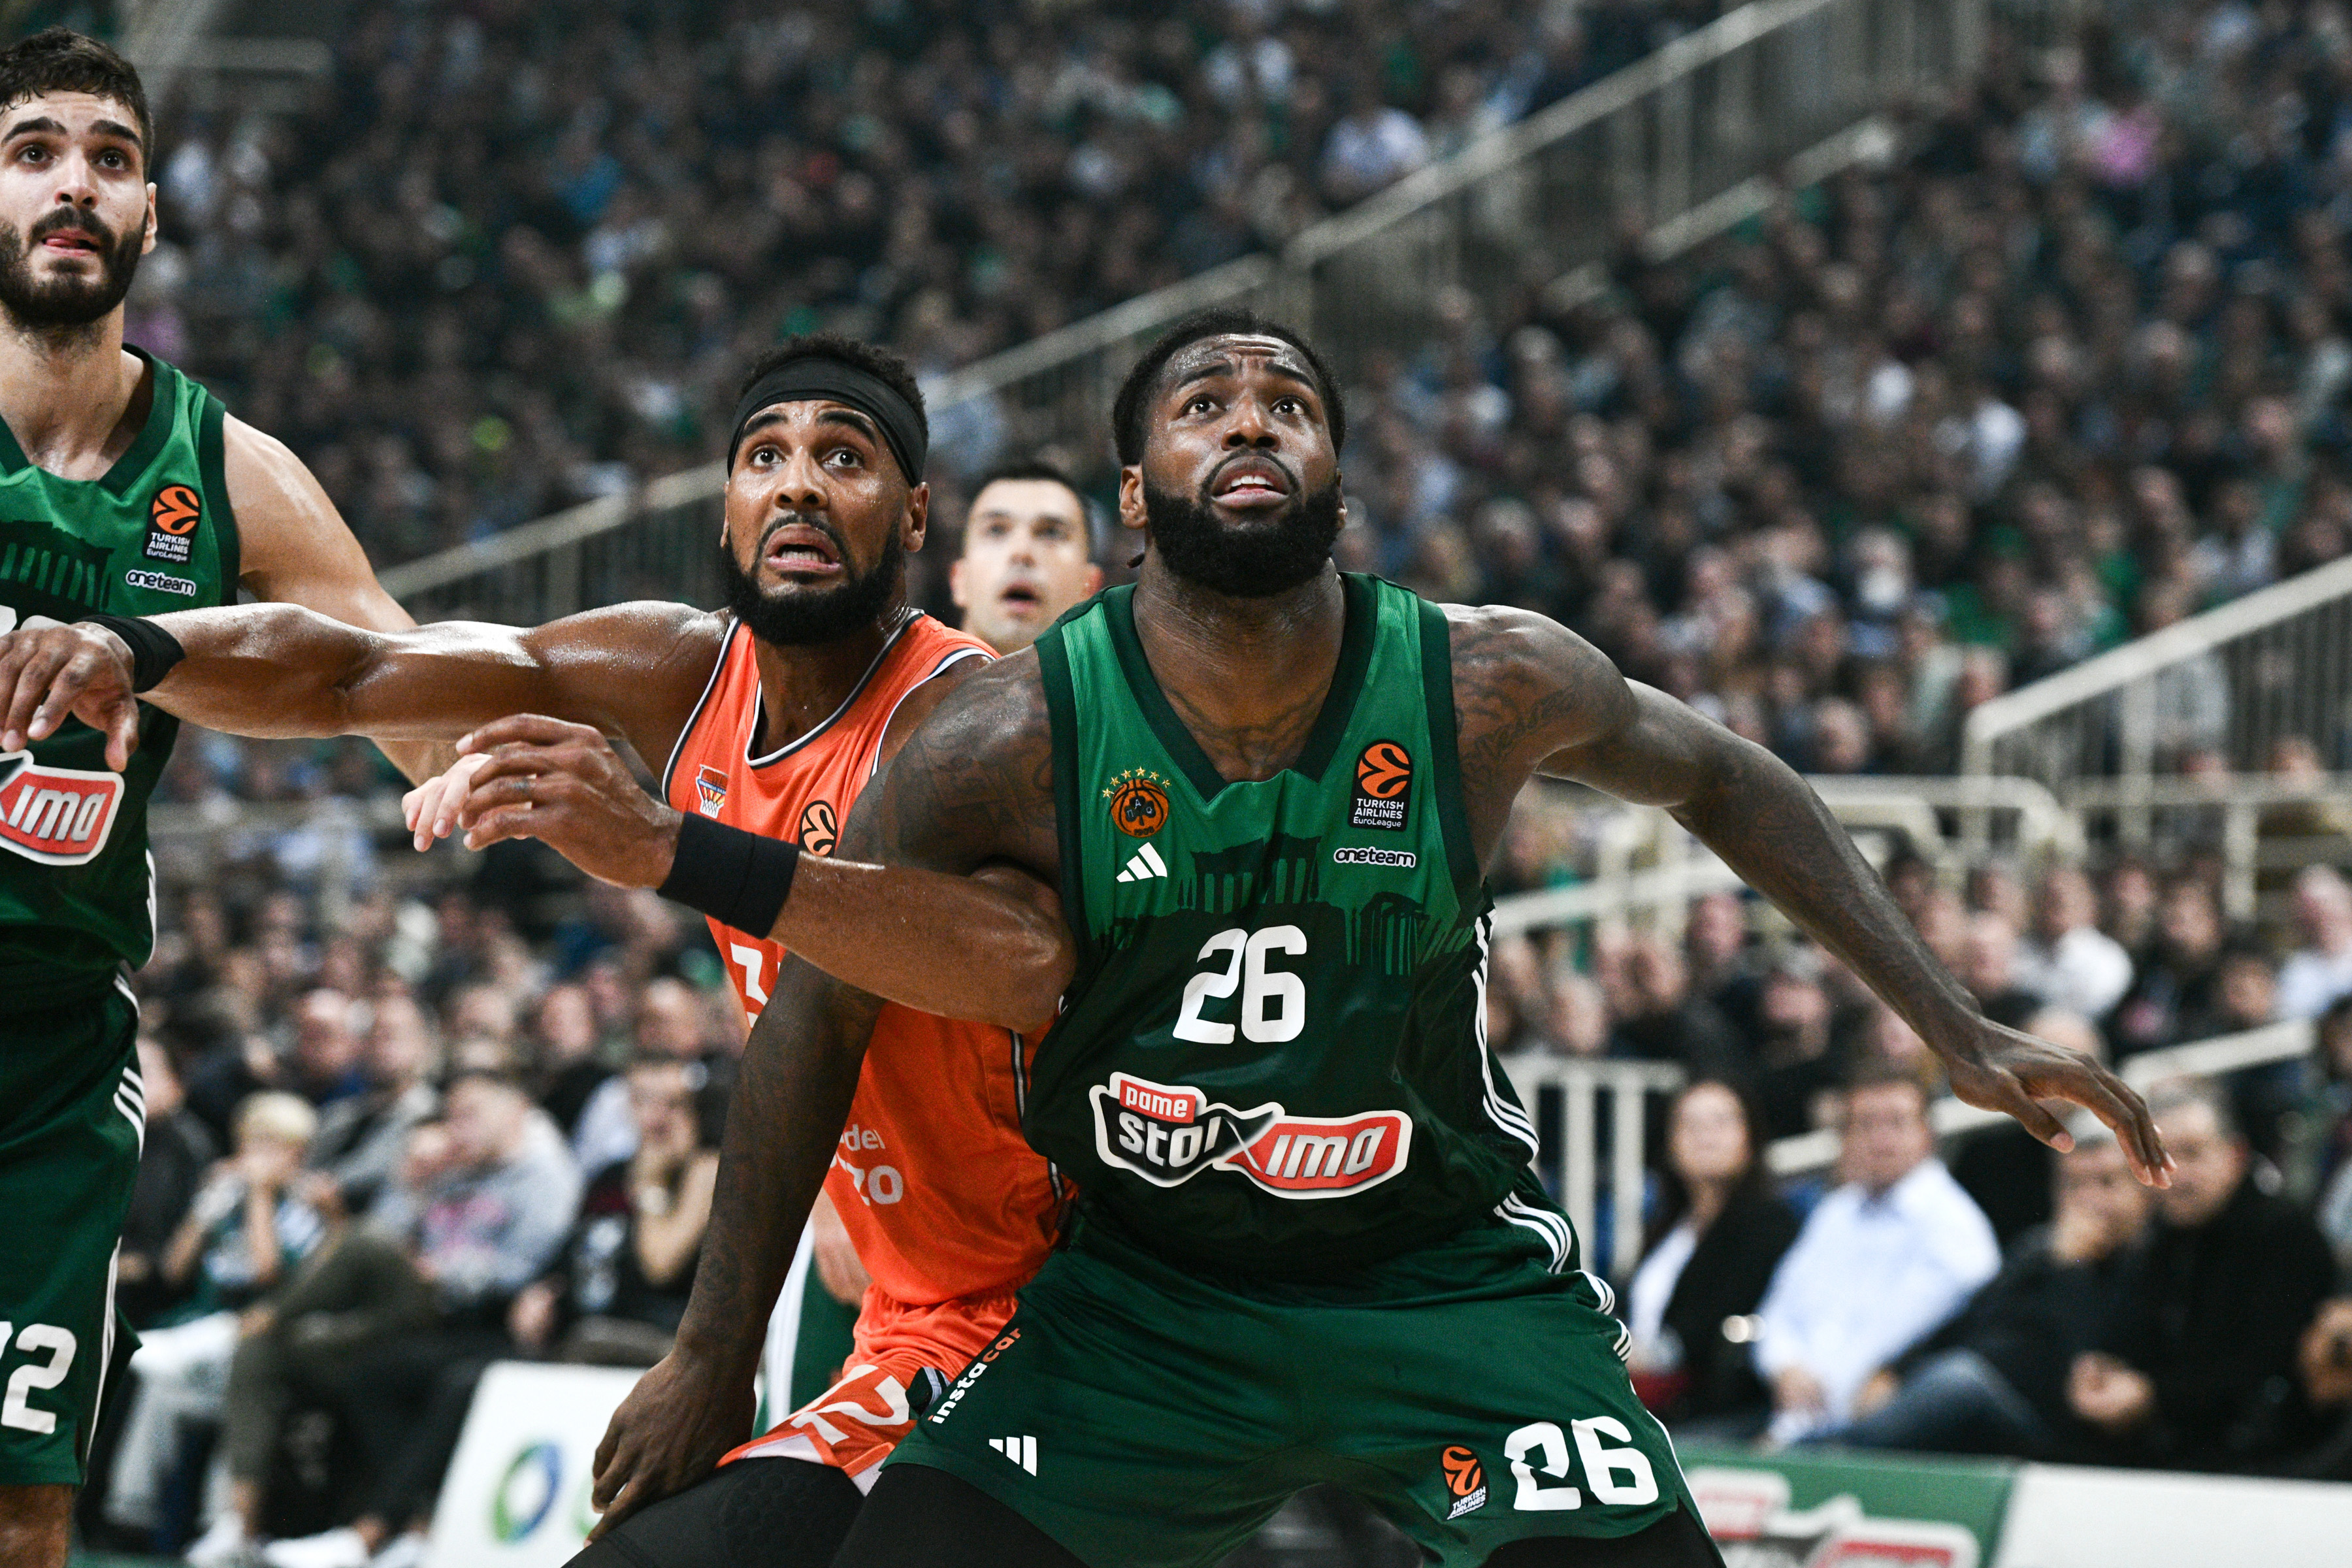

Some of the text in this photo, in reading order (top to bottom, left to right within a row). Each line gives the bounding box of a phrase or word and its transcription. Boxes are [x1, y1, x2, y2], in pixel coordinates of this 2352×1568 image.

[148, 540, 188, 555] AIRLINES
[151, 532, 191, 546] TURKISH
[146, 548, 188, 562] EuroLeague
[127, 570, 195, 596] oneteam
[1354, 808, 1403, 819] AIRLINES
[1357, 798, 1404, 810] TURKISH
[1353, 816, 1401, 828] EuroLeague
[1335, 847, 1415, 867] oneteam
[1173, 924, 1307, 1045] 26
[1125, 1086, 1188, 1118] pame
[0, 1321, 77, 1435] 2
[928, 1328, 1021, 1424] instacar
[1504, 1416, 1659, 1511] 26
[1450, 1494, 1486, 1516] AIRLINES
[1452, 1486, 1486, 1509] TURKISH
